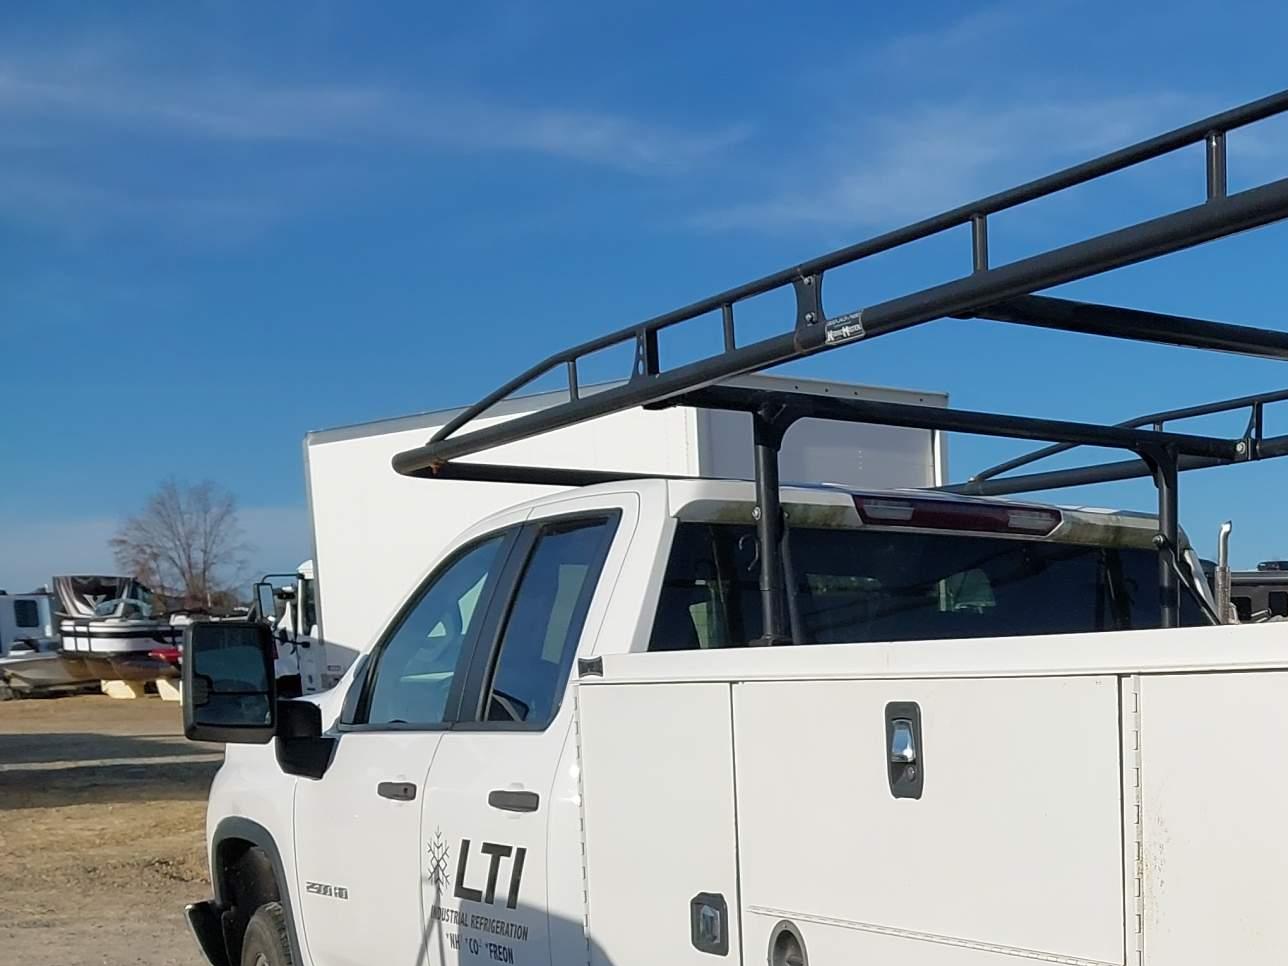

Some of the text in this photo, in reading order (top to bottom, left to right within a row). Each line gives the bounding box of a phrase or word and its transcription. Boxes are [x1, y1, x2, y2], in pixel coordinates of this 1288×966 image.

[454, 839, 527, 910] LTI
[431, 904, 529, 941] INDUSTRIAL REFRIGERATION
